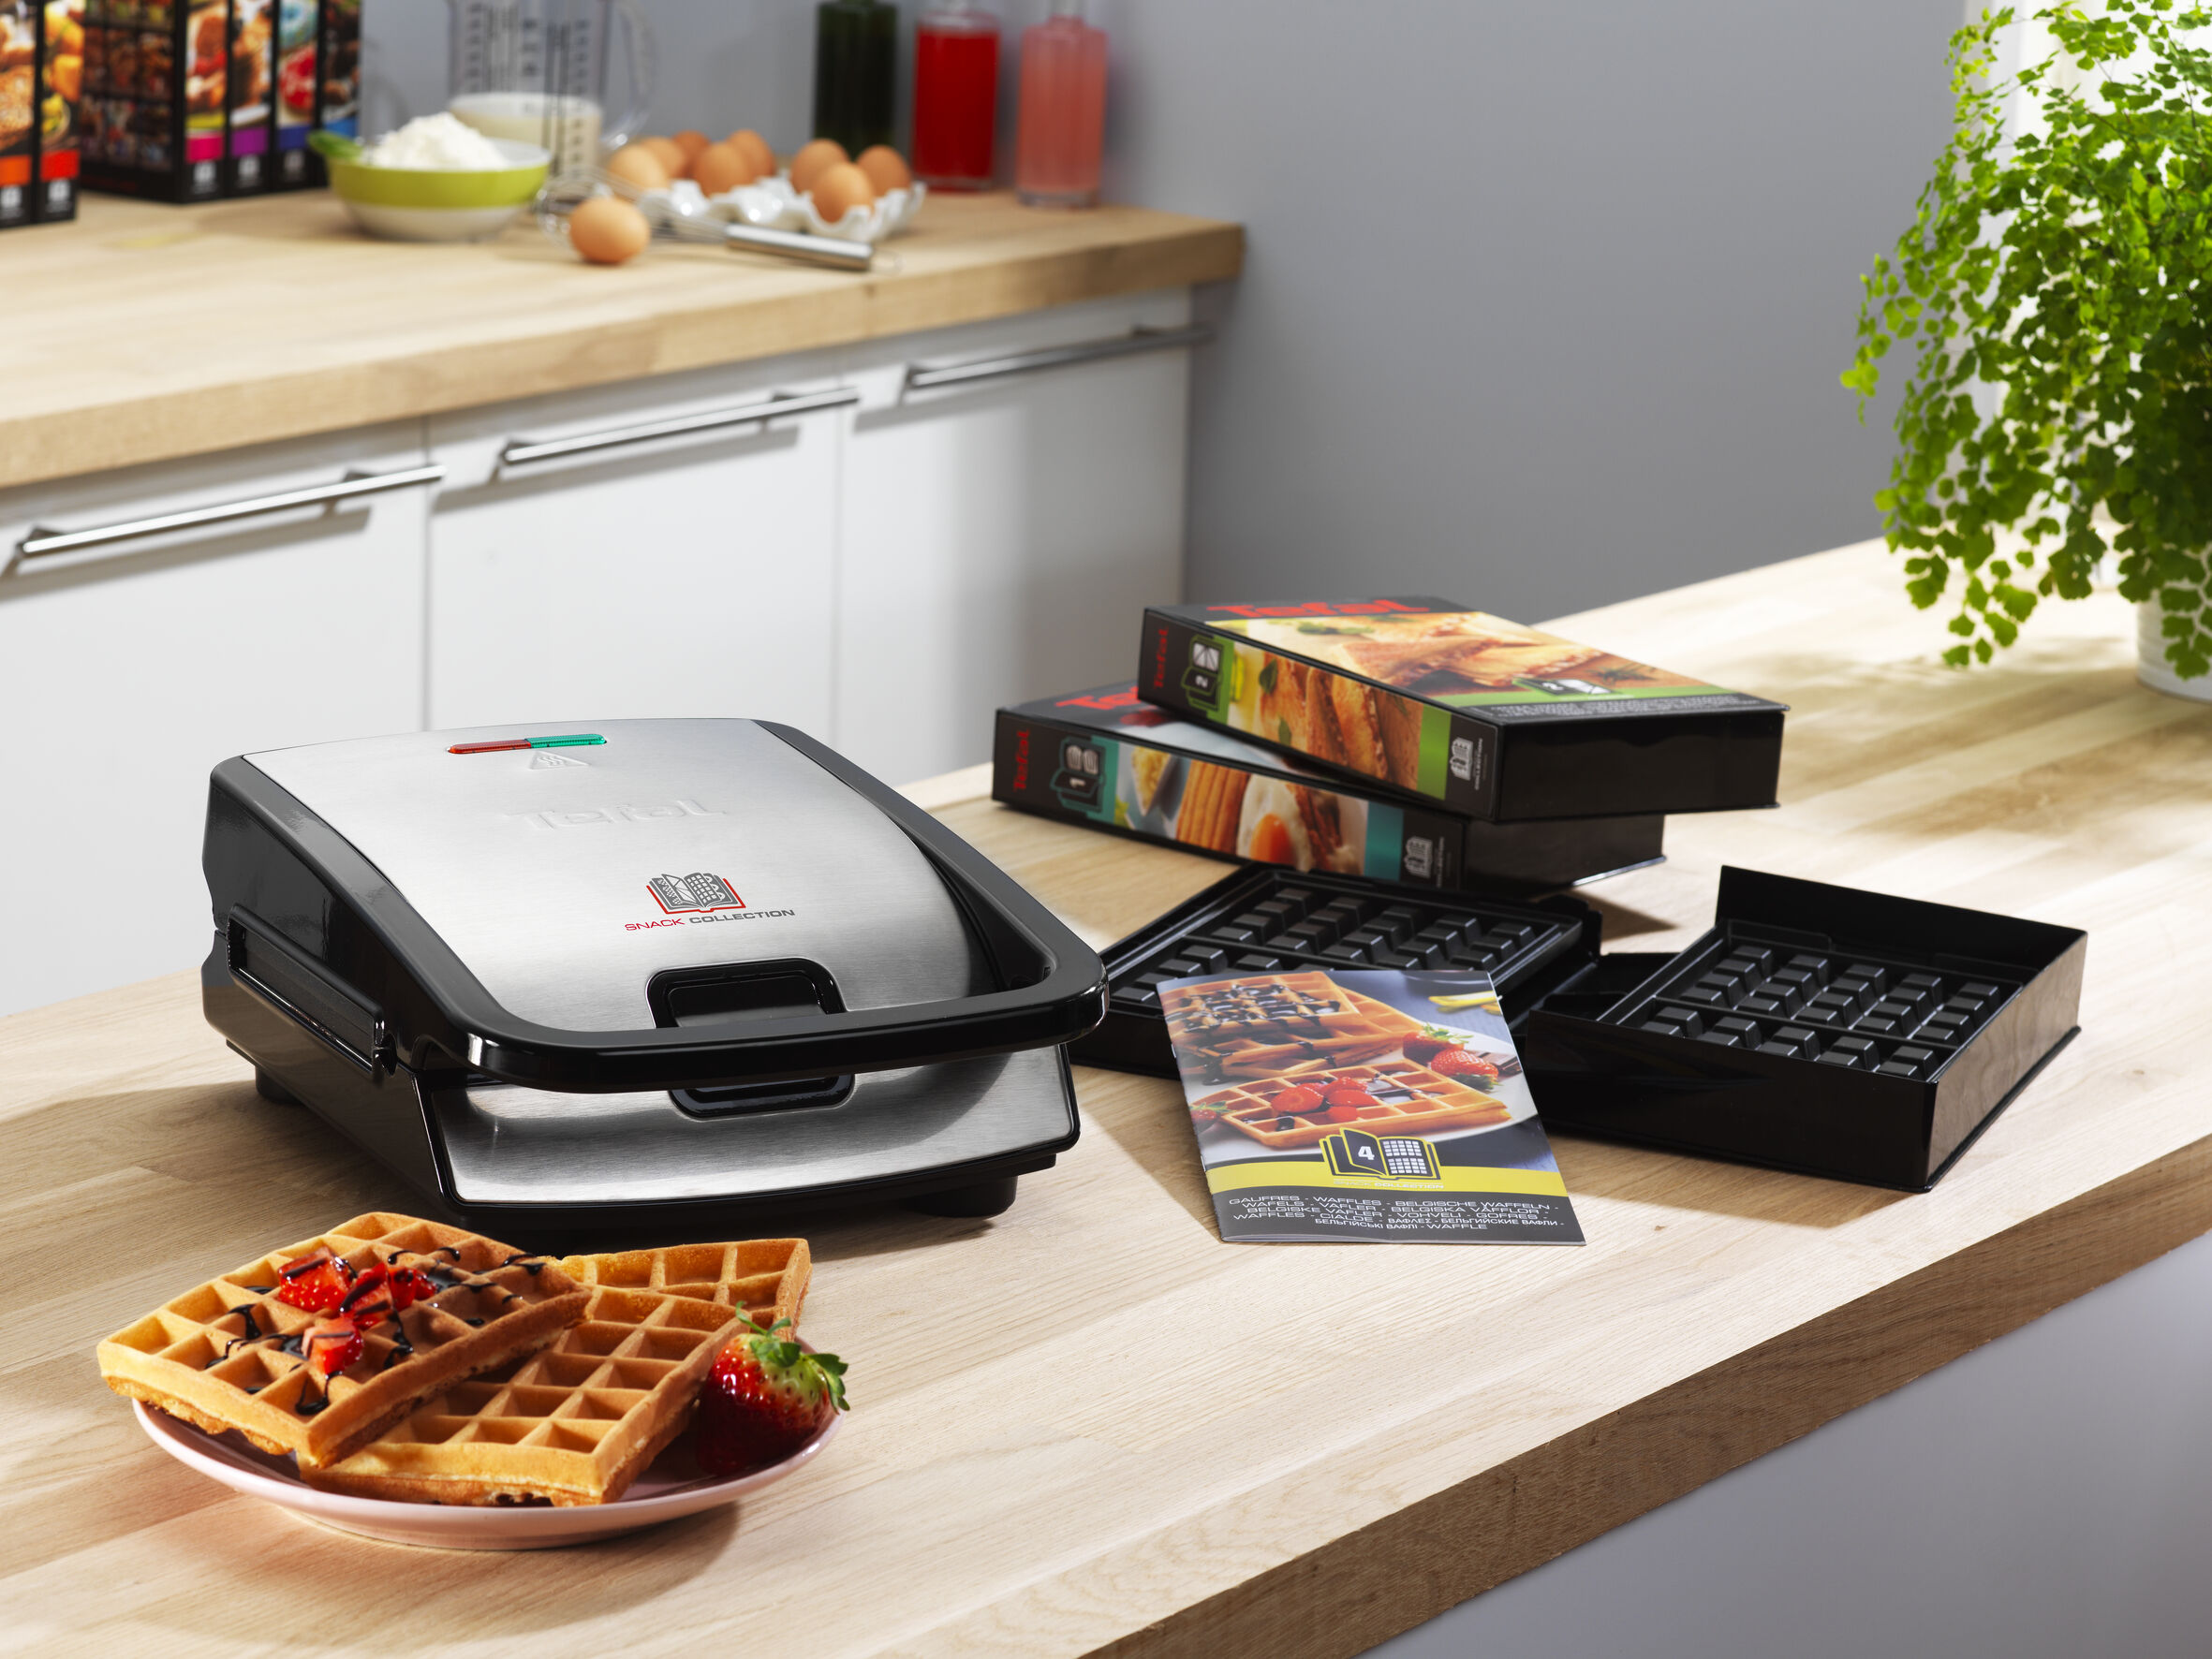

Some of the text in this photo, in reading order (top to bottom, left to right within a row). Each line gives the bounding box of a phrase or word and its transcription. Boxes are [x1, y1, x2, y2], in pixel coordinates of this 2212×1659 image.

[1206, 599, 1430, 618] Tefal
[1153, 626, 1169, 689] Tefal
[504, 799, 728, 830] Tefal
[624, 909, 795, 932] SNACK COLLECTION
[1357, 1146, 1375, 1161] 4
[1229, 1195, 1300, 1205] GAUFRES
[1313, 1197, 1381, 1206] WAFFLES
[1481, 1201, 1550, 1210] WAFFELN
[1320, 1202, 1377, 1211] VAFLER
[1232, 1211, 1305, 1220] WAFFLES
[1320, 1212, 1374, 1223] CIALDE
[1324, 1208, 1383, 1217] VAFLER
